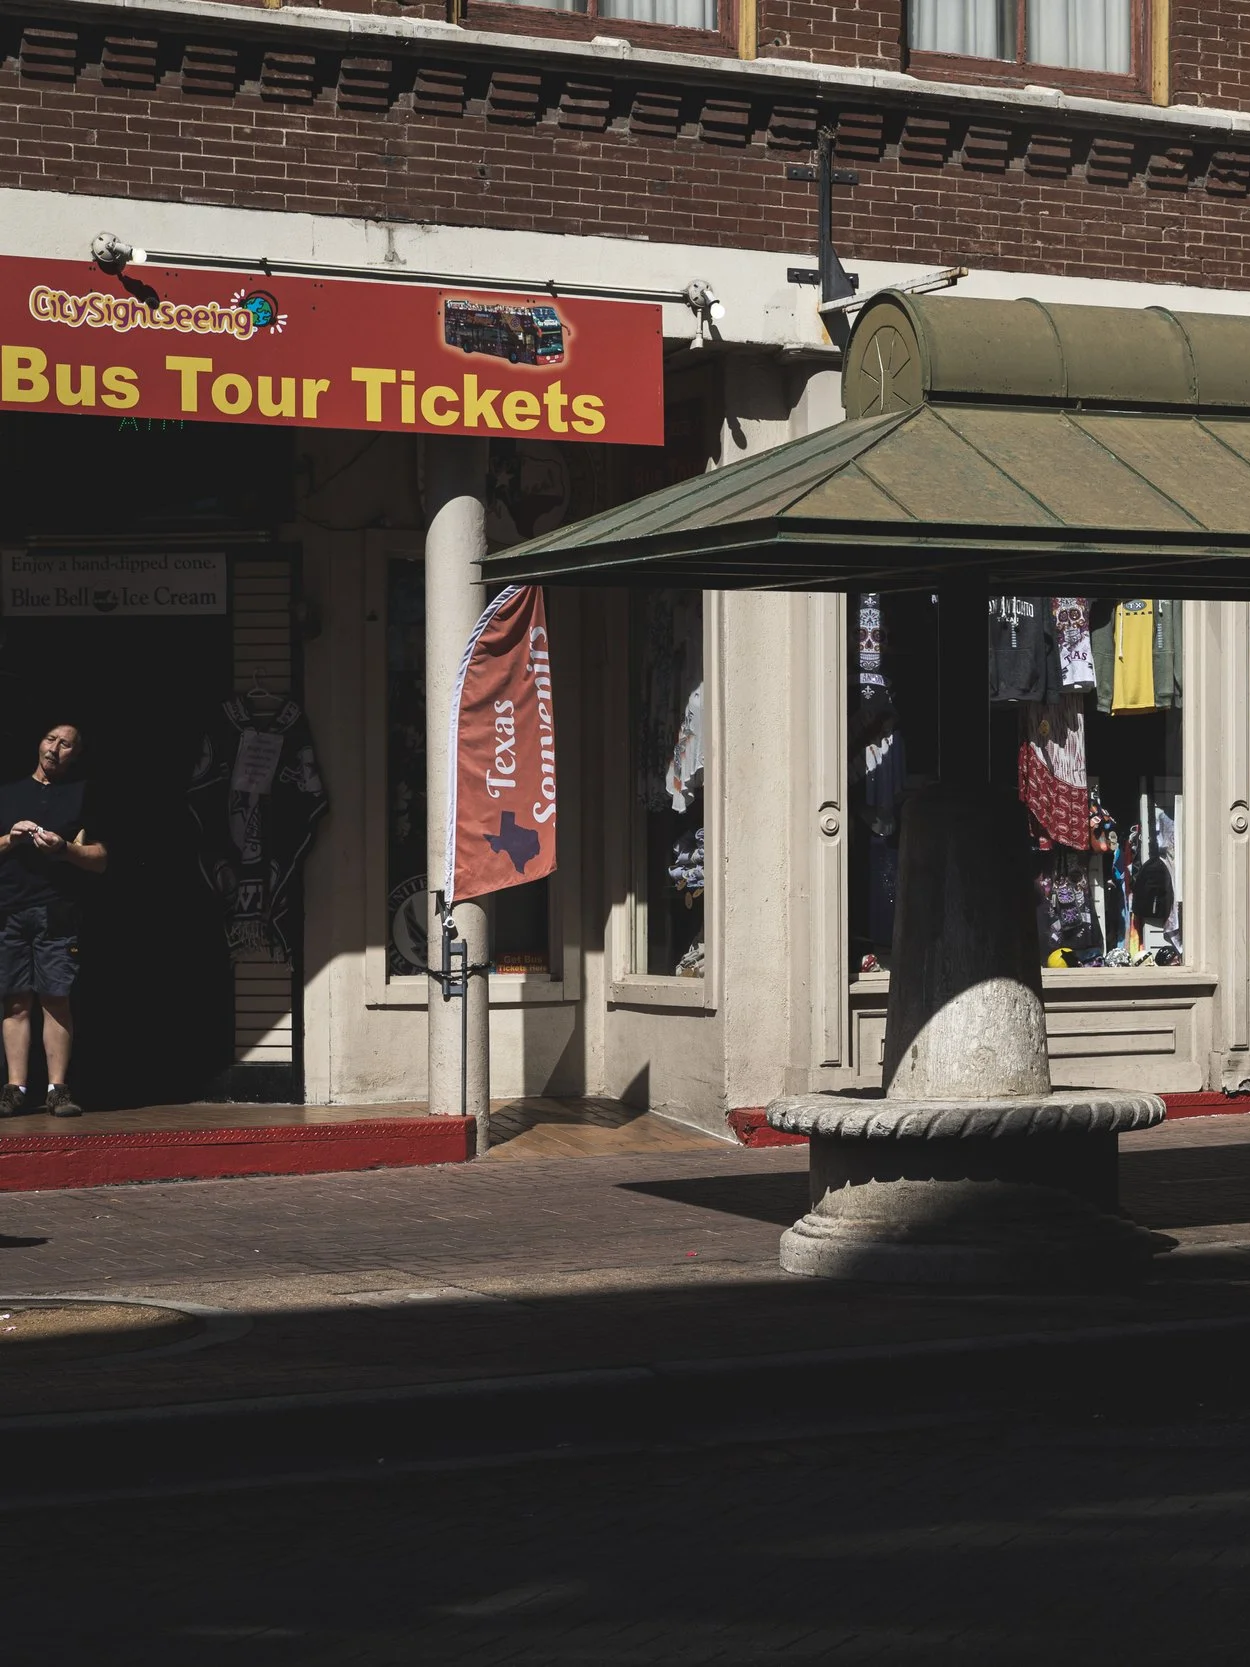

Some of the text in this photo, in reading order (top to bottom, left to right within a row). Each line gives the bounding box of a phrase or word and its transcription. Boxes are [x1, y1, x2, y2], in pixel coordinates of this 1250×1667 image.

[1, 345, 606, 435] Bus Tour Tickets
[11, 554, 217, 575] Enjoy a hand-dipped cone.
[11, 585, 217, 608] Blue Bell Ice Cream
[485, 699, 517, 799] Texas
[526, 625, 557, 828] Souvenirs
